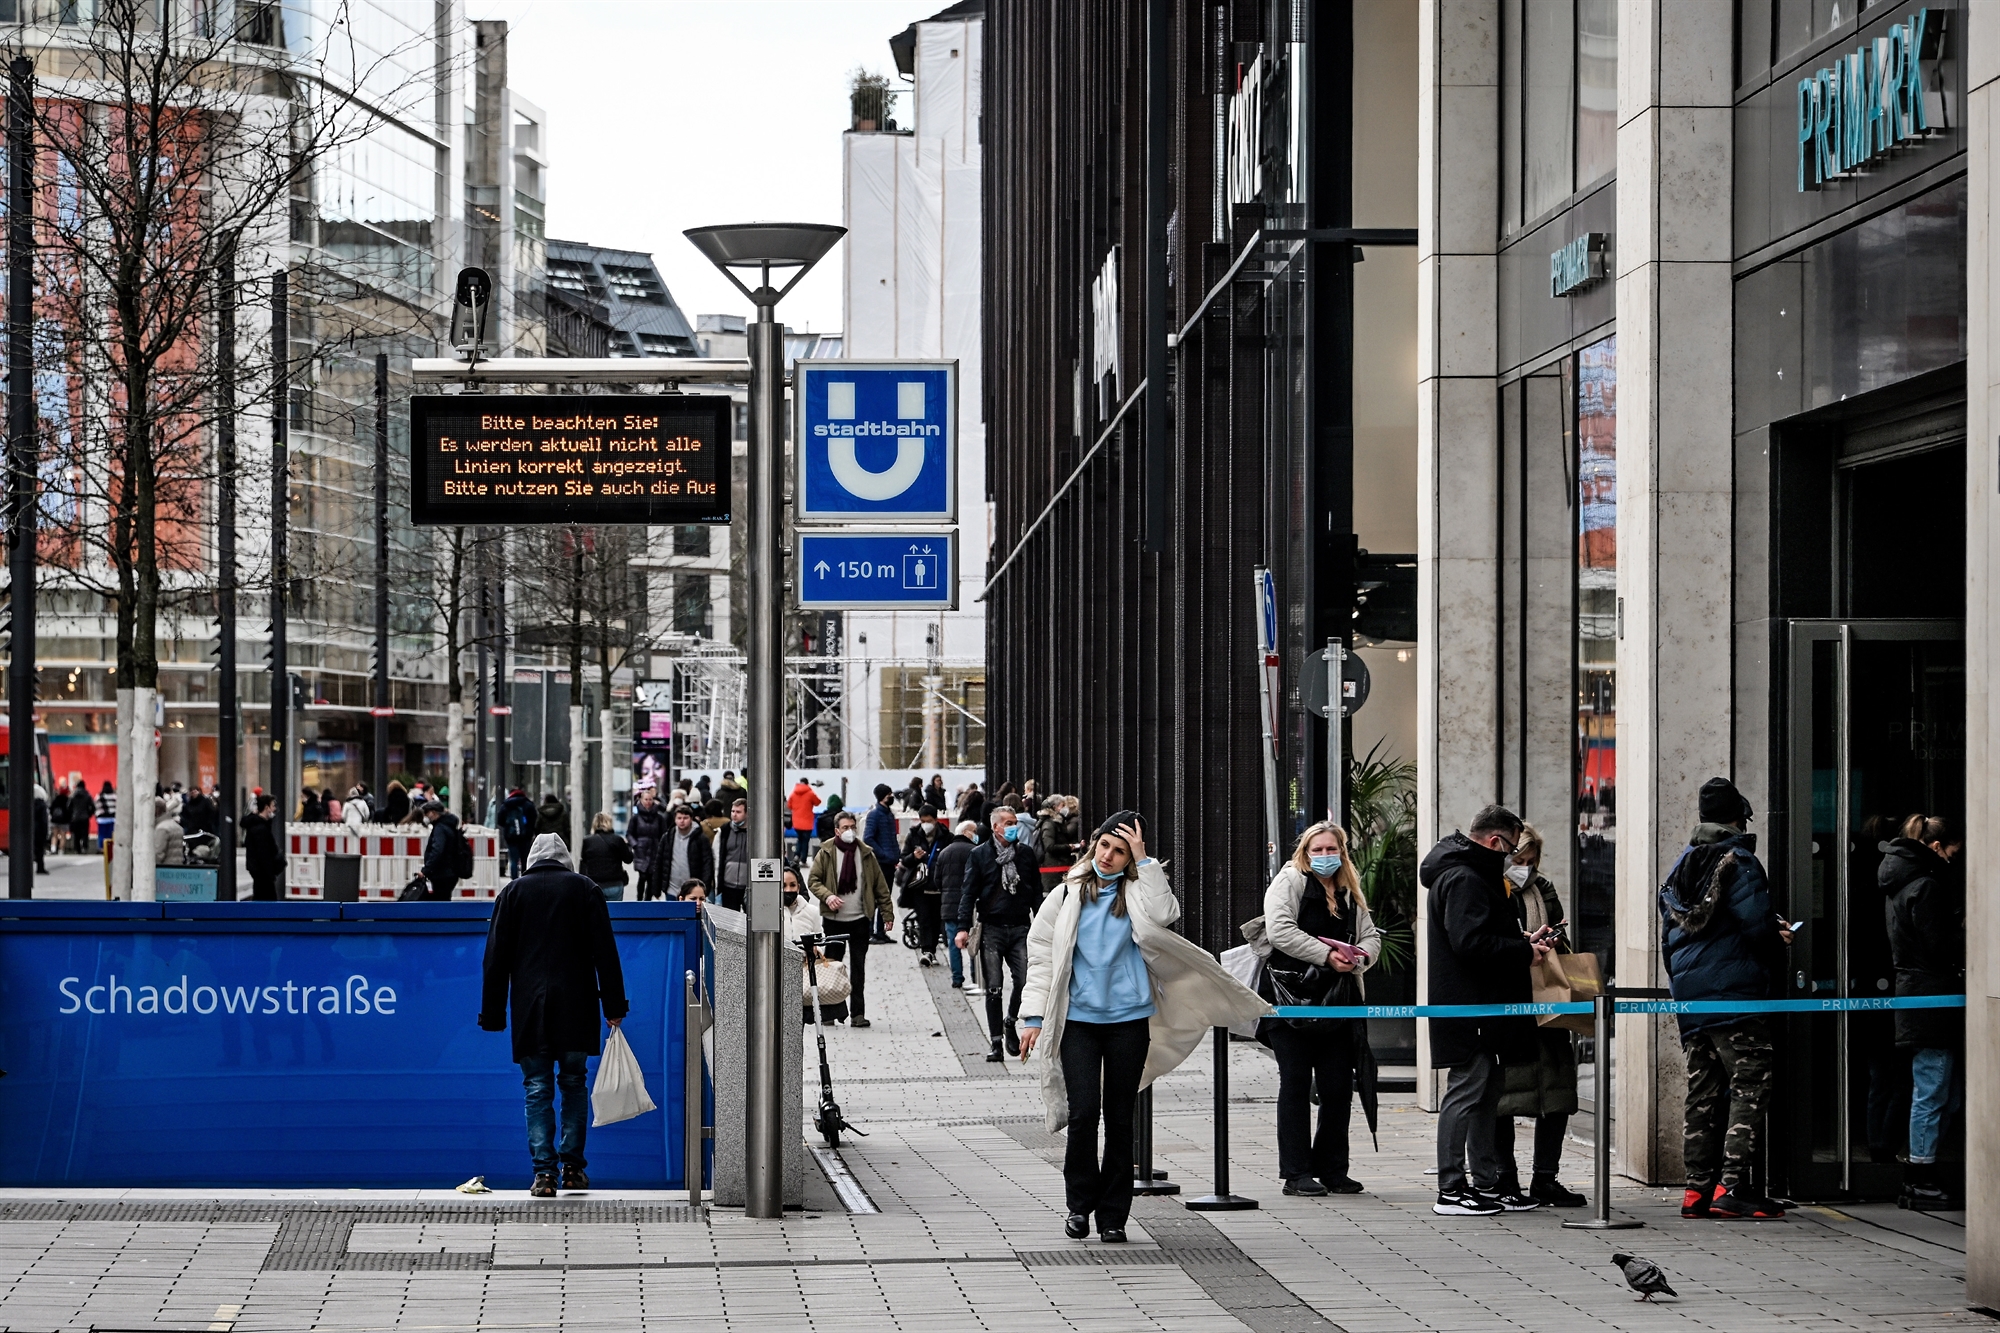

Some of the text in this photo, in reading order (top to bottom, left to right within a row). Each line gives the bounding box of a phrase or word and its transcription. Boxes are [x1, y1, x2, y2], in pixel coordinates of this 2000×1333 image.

[1798, 7, 1927, 192] PRIMARK
[1551, 232, 1590, 298] PRIMARK
[481, 415, 659, 430] Bitte beachten Sie:
[814, 420, 940, 438] stadtbahn
[440, 436, 702, 452] Es werden aktuell nicht alle
[828, 382, 925, 501] U
[455, 459, 688, 477] Linien korrekt angezeigt.
[444, 480, 488, 495] Bitte
[495, 480, 558, 495] nutzen
[564, 480, 594, 495] Sie
[601, 480, 644, 495] auch
[651, 480, 680, 495] die
[837, 562, 895, 579] 150 m
[59, 974, 398, 1016] Schadowstraße
[1367, 1007, 1416, 1017] PRIMARK
[1504, 1004, 1554, 1015] PRIMARK
[1619, 1002, 1690, 1013] PRIMARK
[1822, 999, 1893, 1010] PRIMARK
